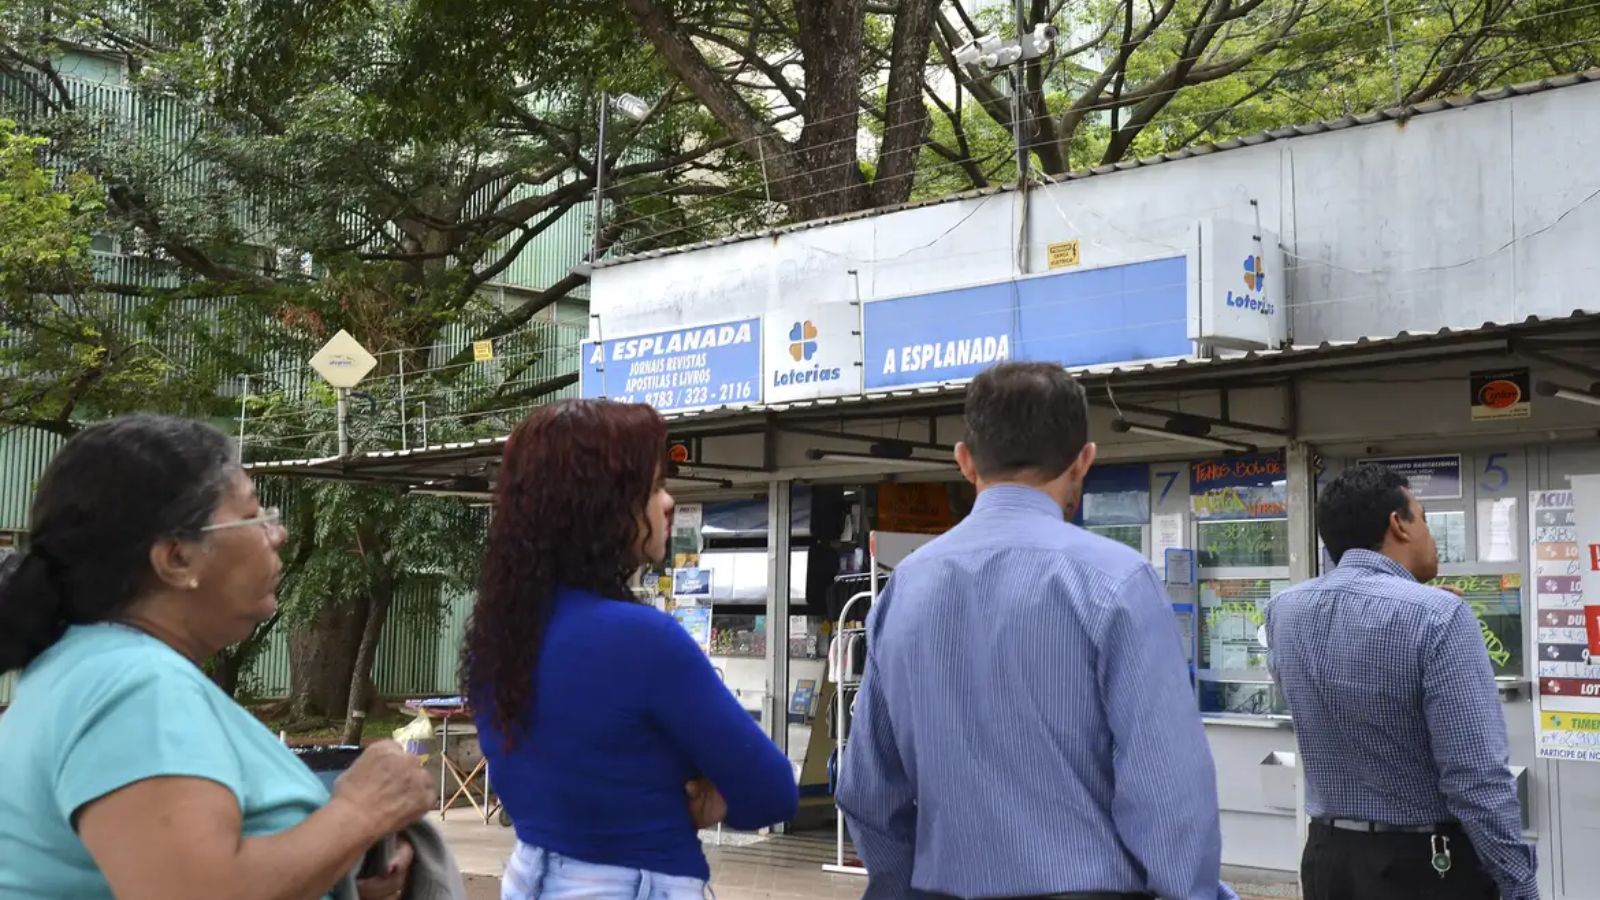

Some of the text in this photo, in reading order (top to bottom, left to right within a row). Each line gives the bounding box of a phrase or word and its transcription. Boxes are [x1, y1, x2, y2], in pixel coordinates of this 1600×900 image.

[590, 323, 753, 365] A ESPLANADA
[882, 333, 1009, 374] A ESPLANADA
[629, 353, 707, 377] JORNAIS REVISTAS
[773, 363, 841, 388] Loterias
[625, 369, 711, 393] APOSTILAS E LIVROS
[645, 391, 673, 409] 8783
[684, 387, 708, 404] 323
[719, 381, 752, 402] 2116
[1481, 452, 1510, 492] 5
[1155, 471, 1181, 506] 7
[1580, 683, 1600, 696] LOT
[1540, 748, 1576, 759] PARTICIPE
[1577, 750, 1587, 760] DE
